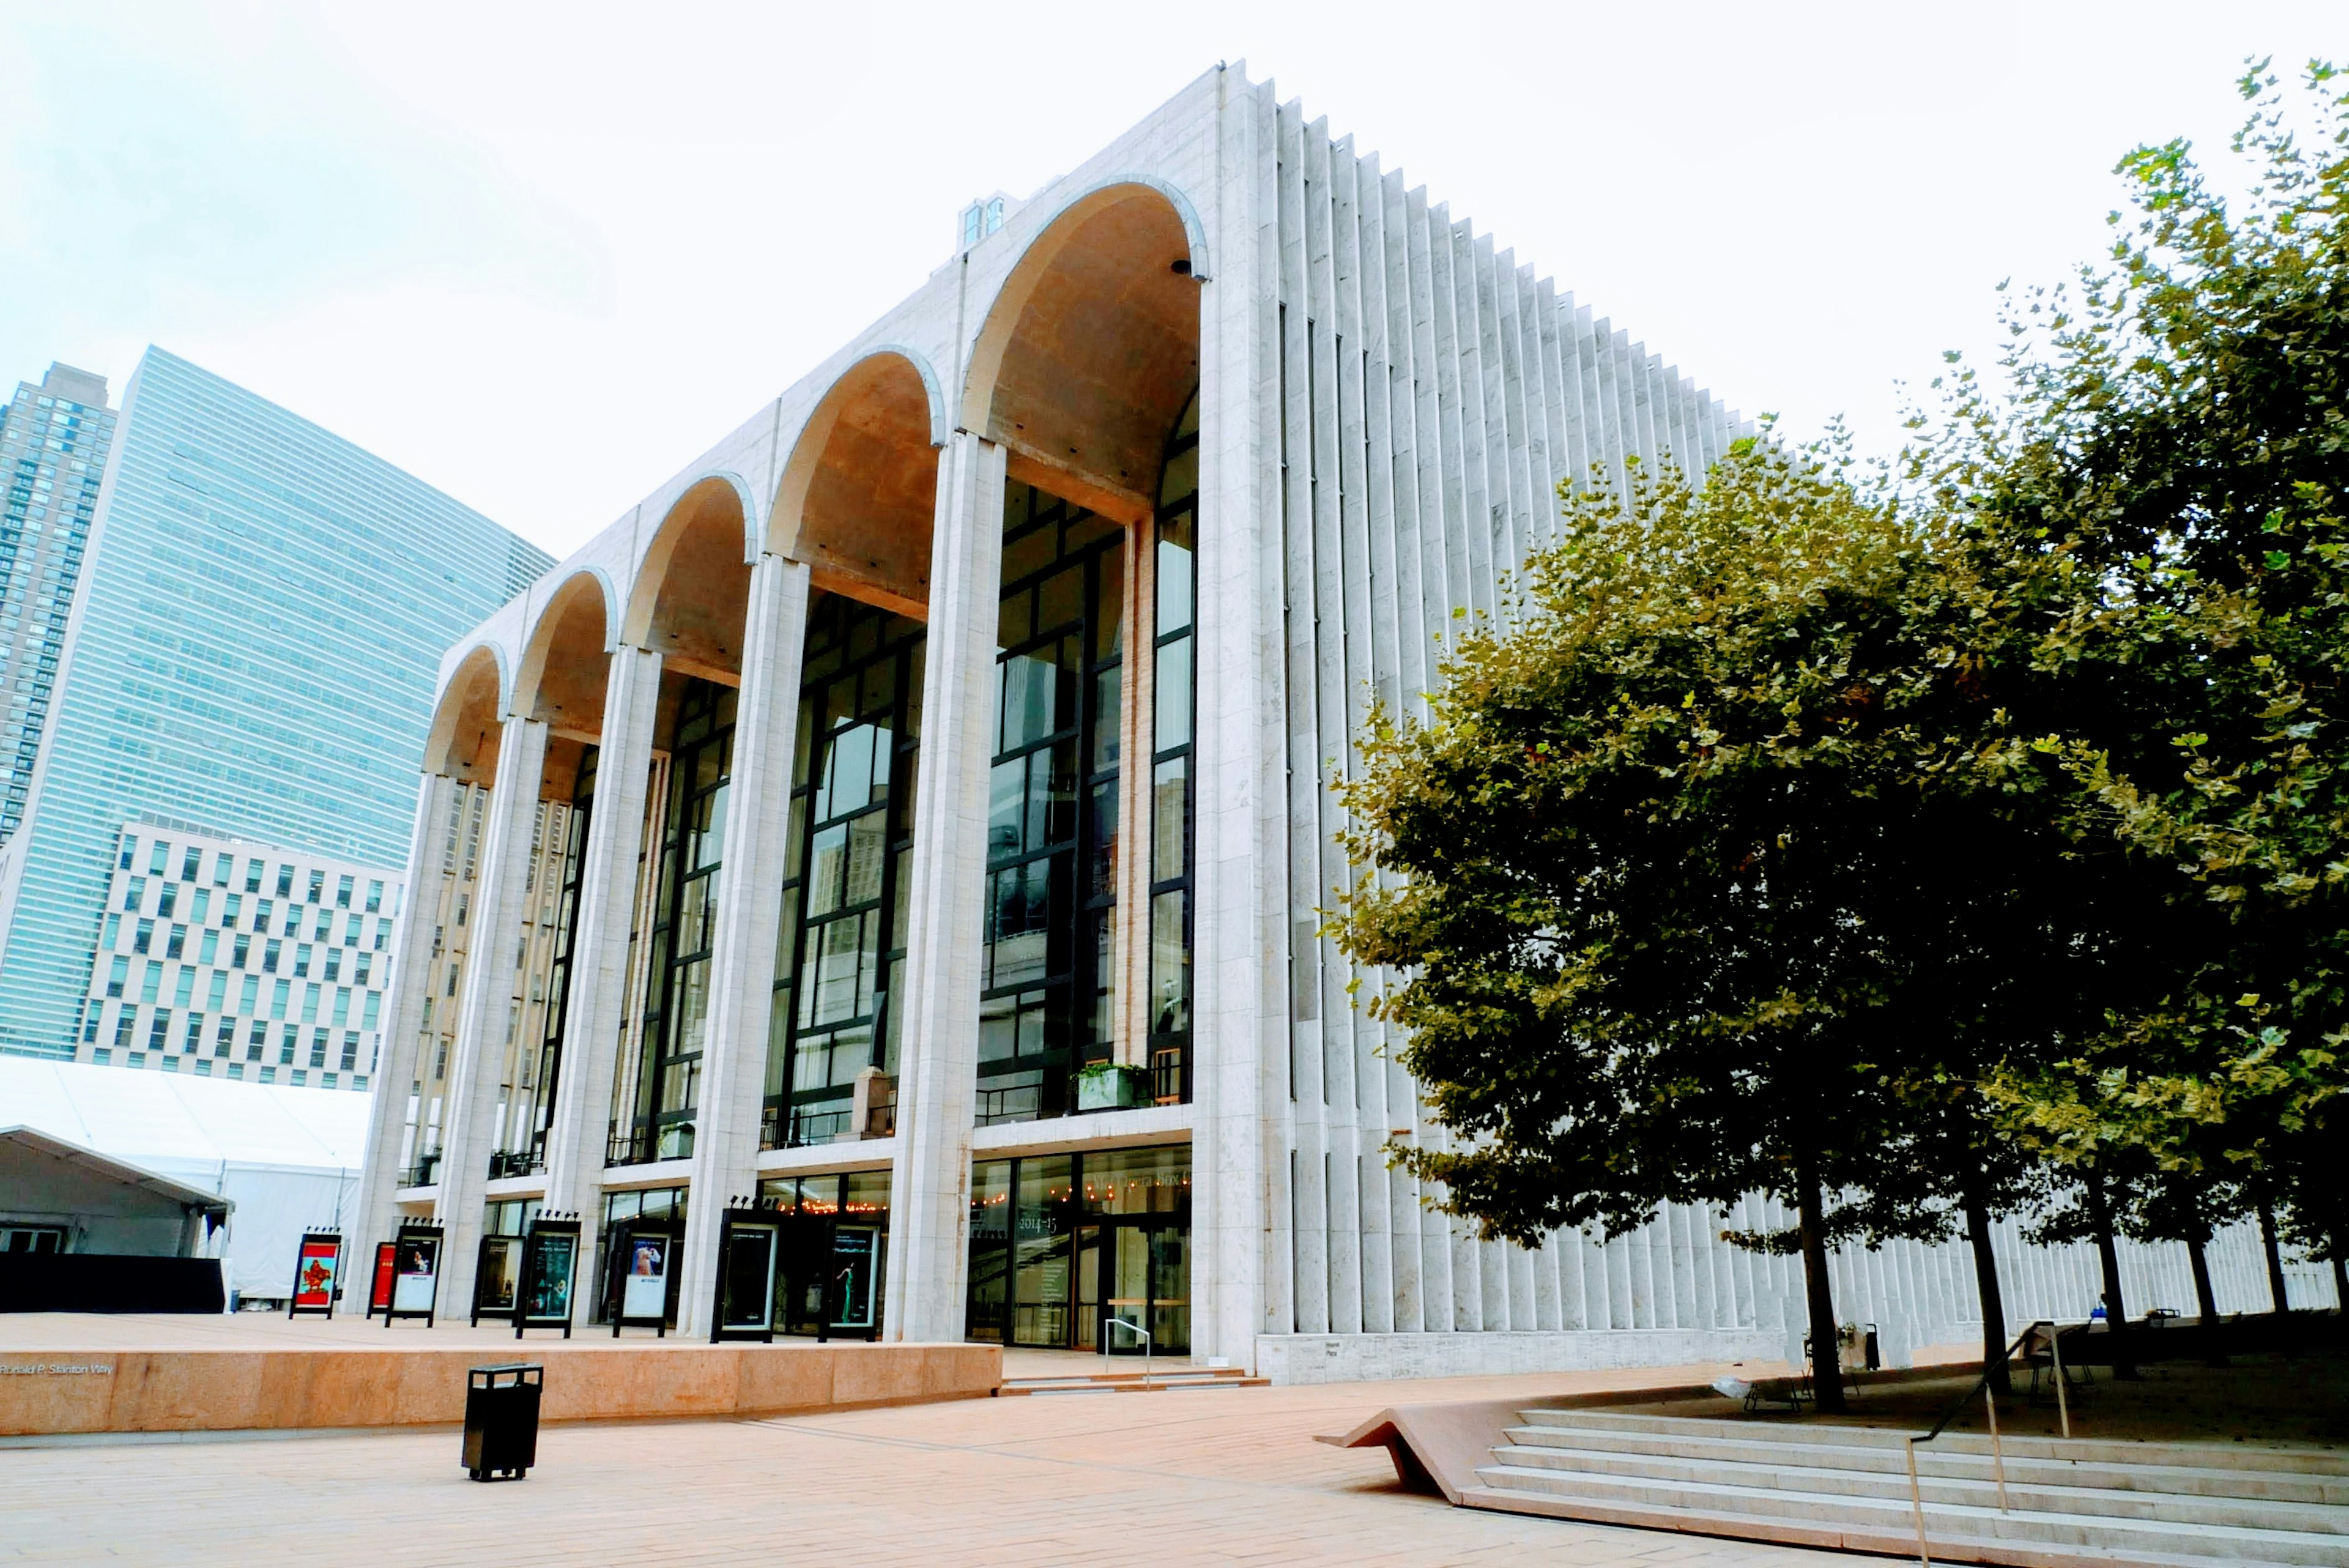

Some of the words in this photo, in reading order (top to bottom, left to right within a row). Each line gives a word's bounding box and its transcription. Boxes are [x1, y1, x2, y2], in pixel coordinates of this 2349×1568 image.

[1019, 1217, 1057, 1234] 2014-15
[49, 1364, 88, 1373] Stanton
[91, 1364, 112, 1374] Way
